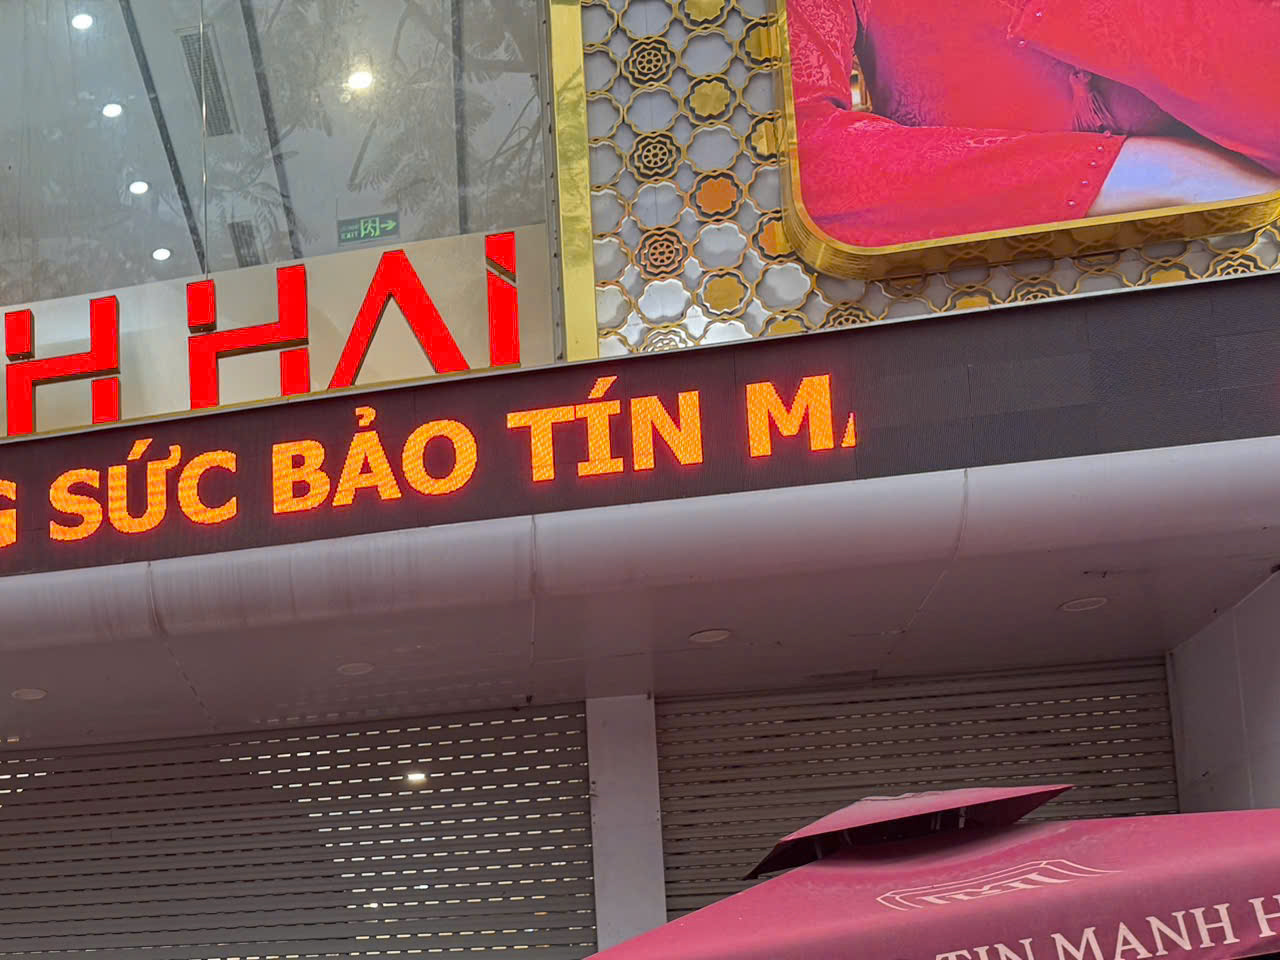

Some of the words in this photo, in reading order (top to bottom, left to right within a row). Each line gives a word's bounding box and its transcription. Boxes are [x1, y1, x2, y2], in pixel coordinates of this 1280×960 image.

[49, 439, 237, 542] SỨC
[272, 407, 478, 514] BẢO
[506, 376, 704, 482] TÍN
